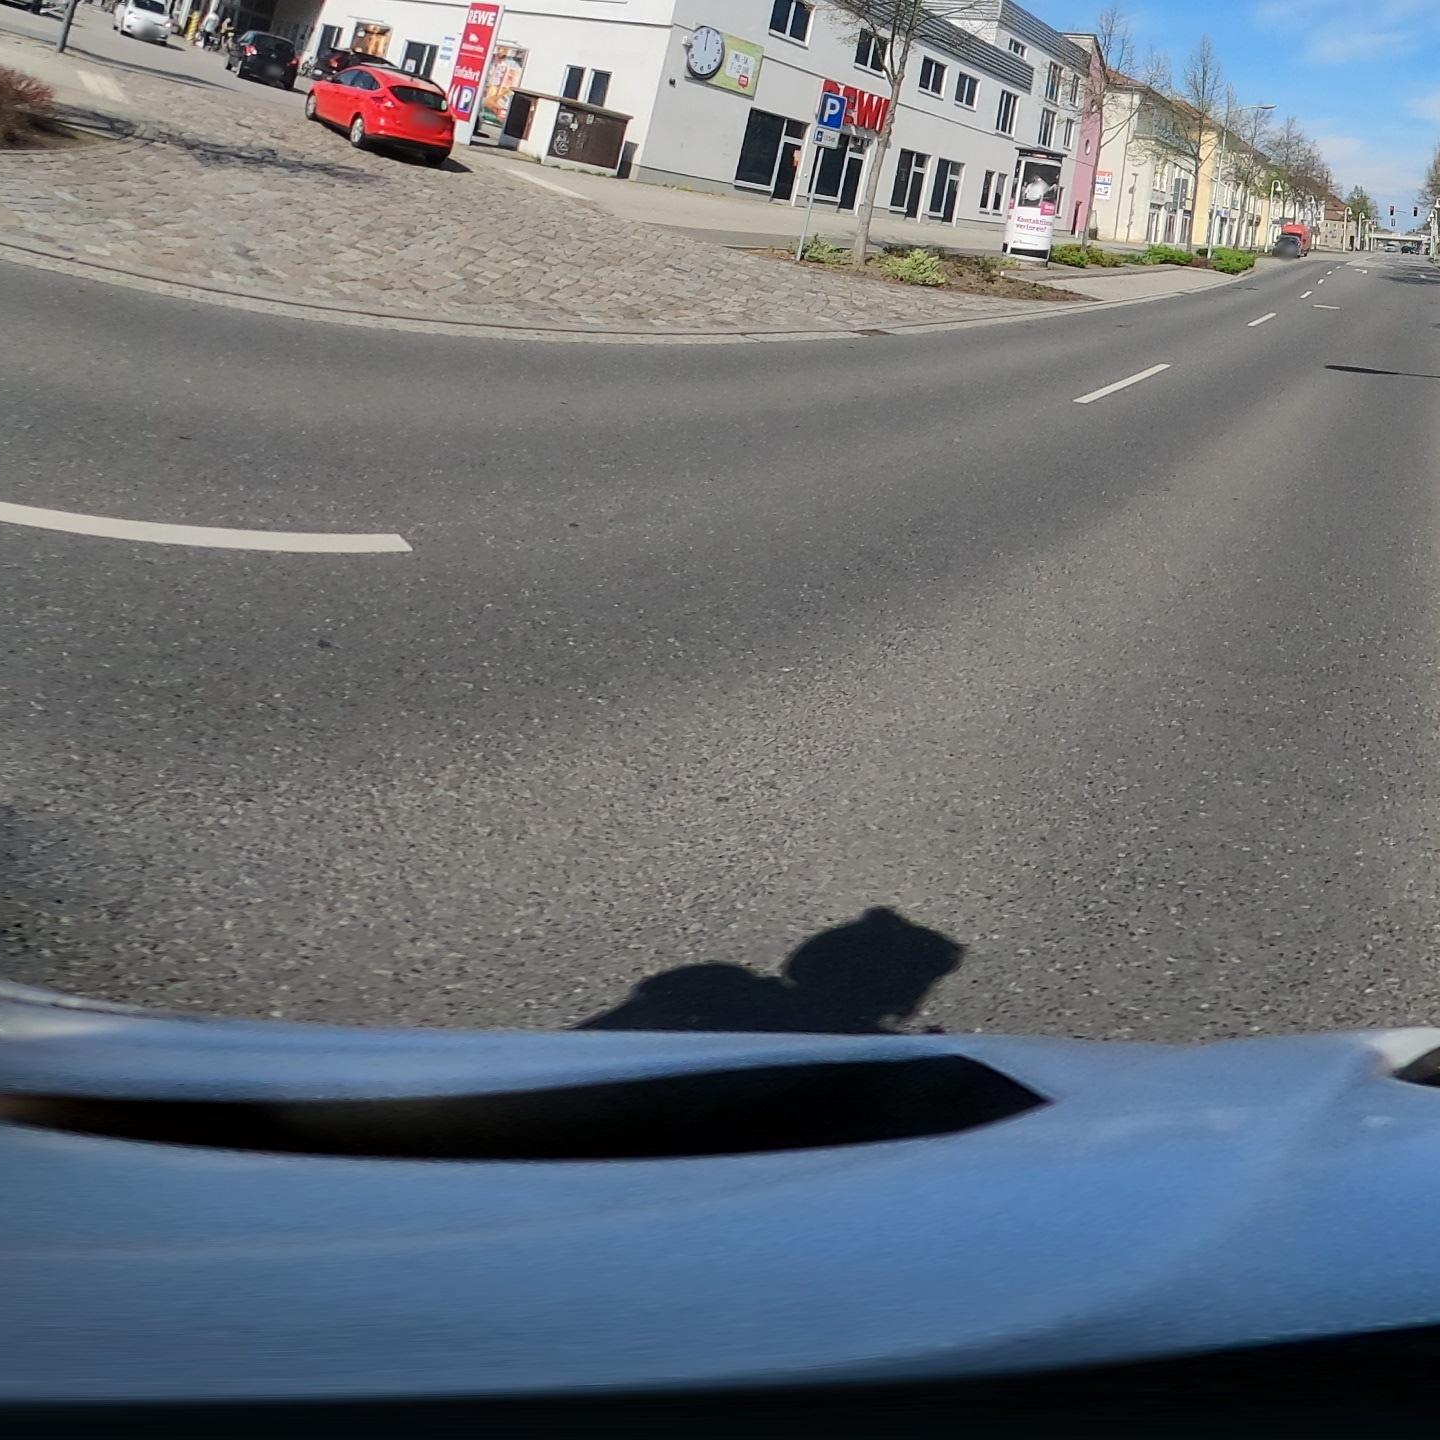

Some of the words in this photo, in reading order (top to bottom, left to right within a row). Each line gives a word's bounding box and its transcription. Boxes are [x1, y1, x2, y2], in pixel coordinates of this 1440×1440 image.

[467, 9, 497, 27] REWE
[459, 90, 472, 111] P
[823, 98, 840, 123] P
